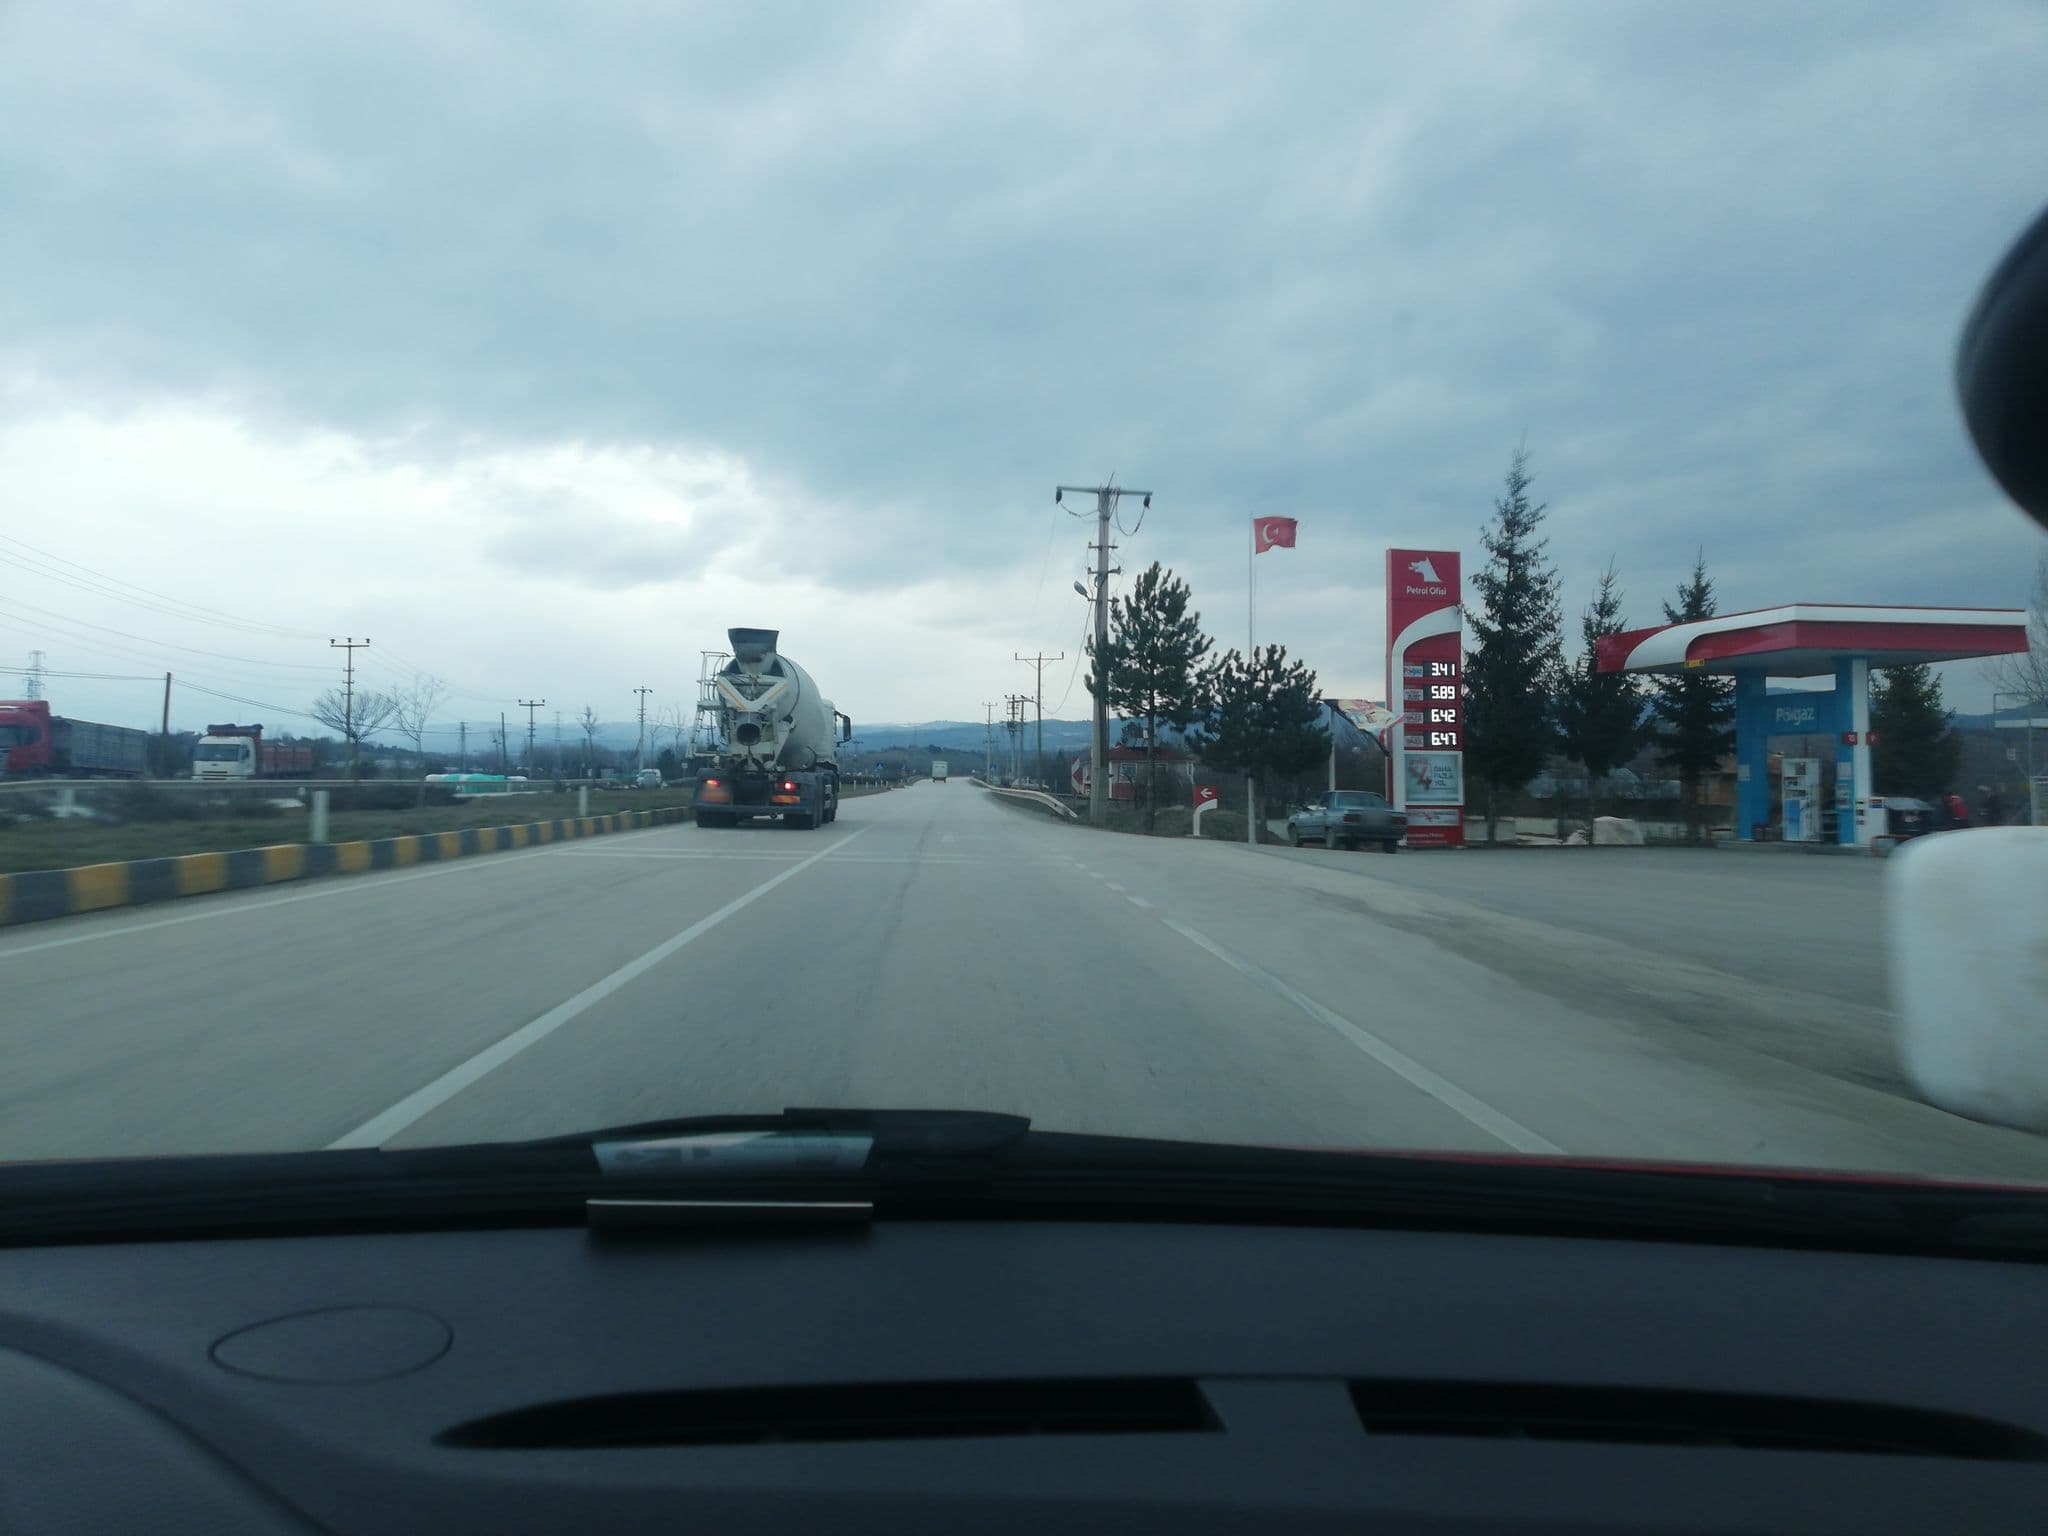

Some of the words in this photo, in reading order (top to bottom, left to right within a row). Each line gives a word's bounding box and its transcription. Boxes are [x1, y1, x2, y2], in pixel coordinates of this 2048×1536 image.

[1406, 585, 1428, 595] Petrol
[1429, 586, 1447, 596] Ofisi
[1431, 662, 1455, 676] 3.41
[1431, 685, 1455, 699] 5.89
[1431, 708, 1455, 722] 6.42
[1431, 732, 1457, 746] 6.47
